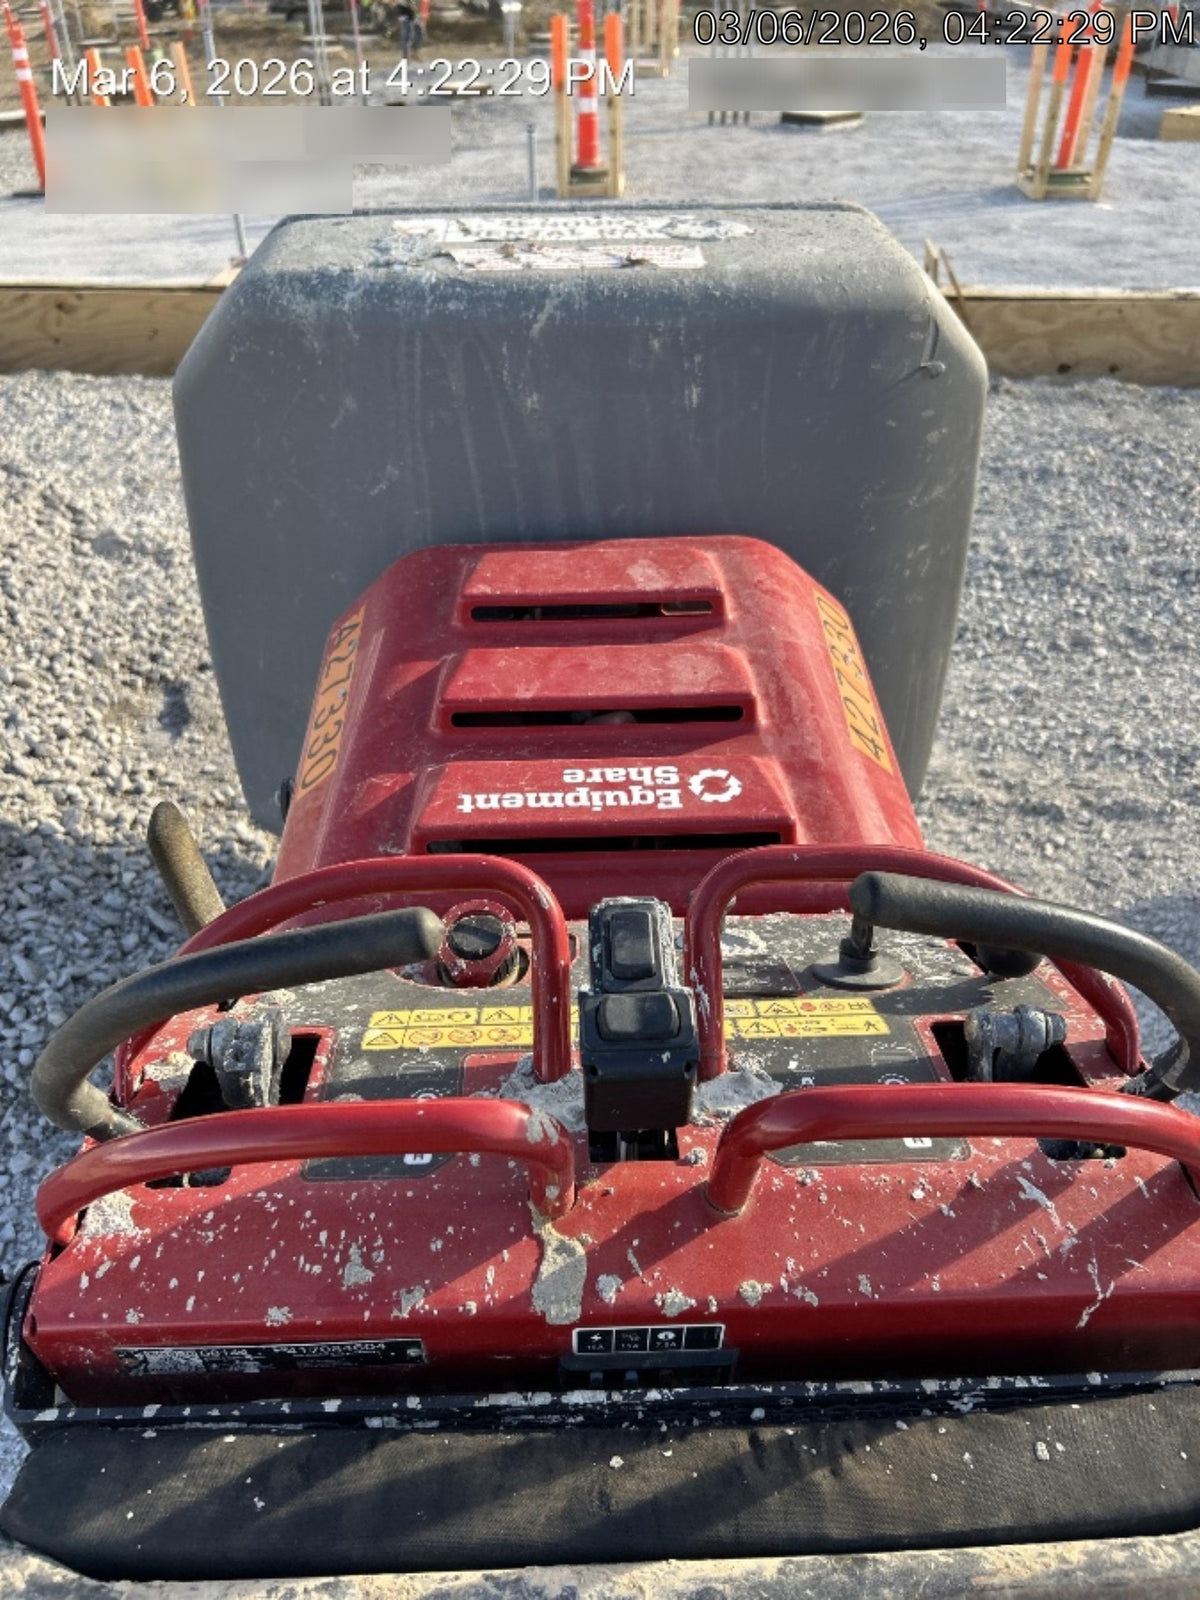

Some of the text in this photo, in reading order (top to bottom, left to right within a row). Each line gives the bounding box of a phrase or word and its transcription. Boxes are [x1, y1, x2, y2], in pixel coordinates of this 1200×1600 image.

[301, 621, 361, 790] 427330
[816, 596, 885, 761] 427330
[457, 785, 683, 813] Equipment
[562, 765, 680, 784] Share
